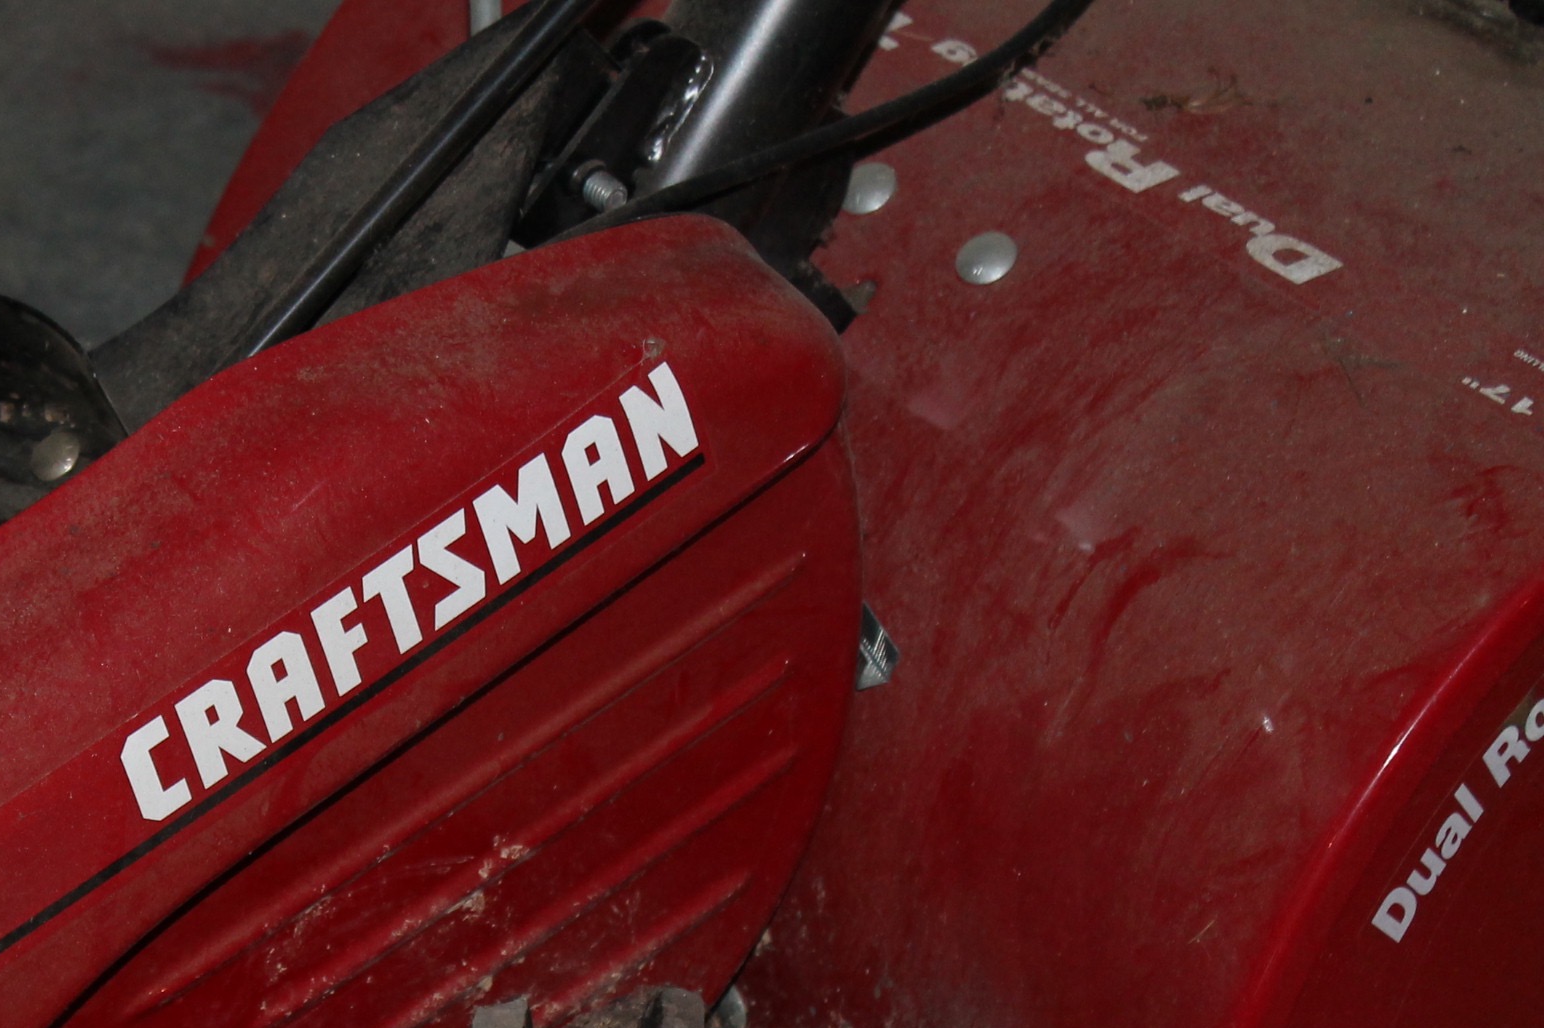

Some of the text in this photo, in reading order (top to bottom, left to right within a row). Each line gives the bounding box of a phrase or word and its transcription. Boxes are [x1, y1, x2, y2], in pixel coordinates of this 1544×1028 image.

[1178, 185, 1344, 285] Dual
[120, 361, 699, 821] CRAFTSMAN
[1371, 783, 1484, 943] Dual
